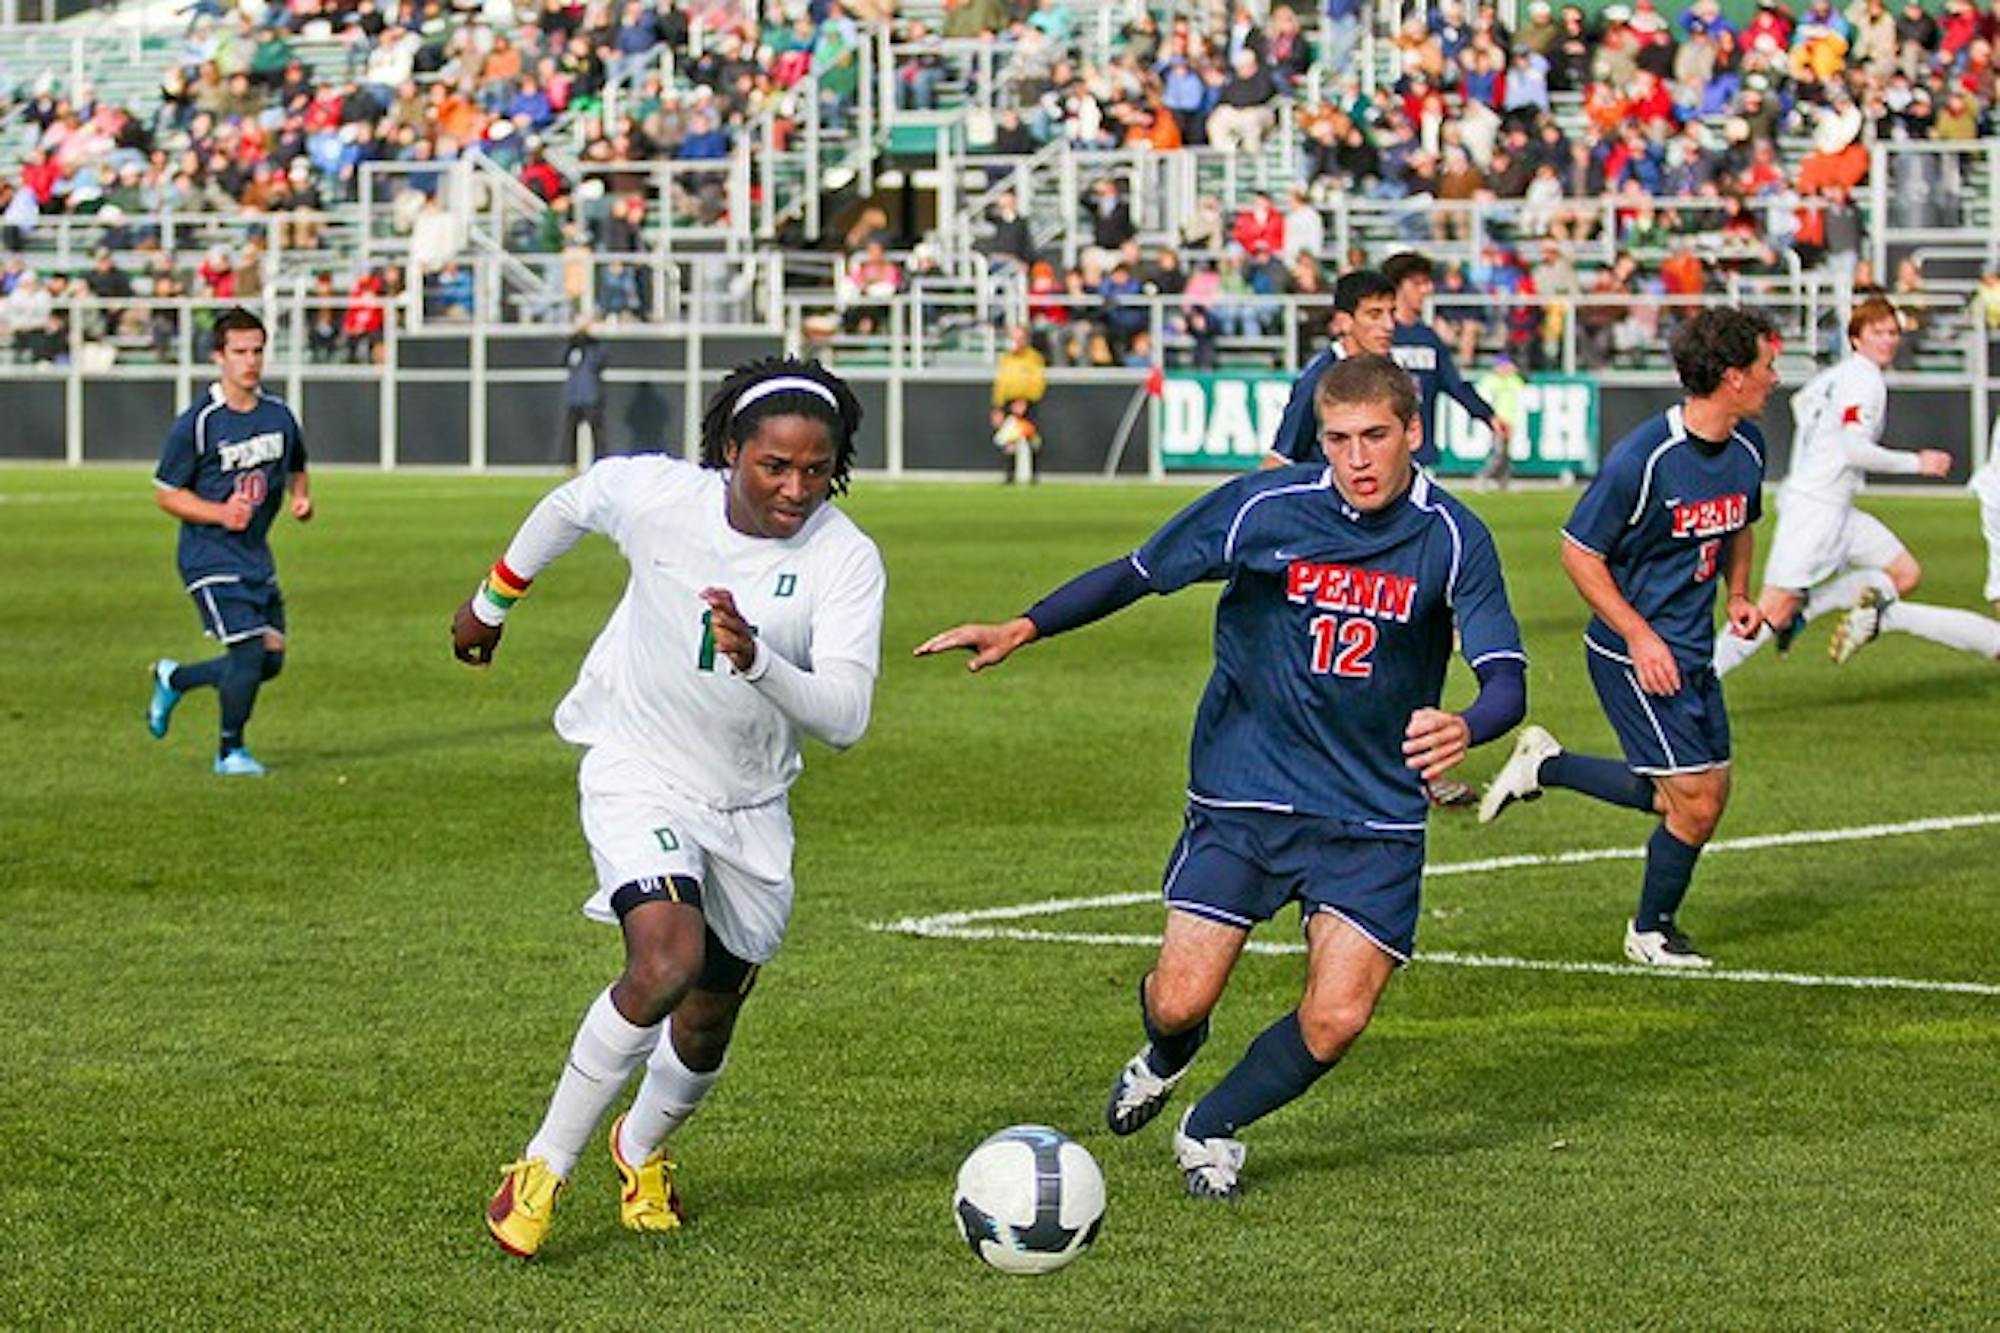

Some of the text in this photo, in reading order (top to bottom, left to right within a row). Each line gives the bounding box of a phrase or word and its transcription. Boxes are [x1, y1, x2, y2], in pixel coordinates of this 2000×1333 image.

[774, 573, 797, 597] D
[1287, 559, 1418, 623] PENN
[1310, 614, 1378, 678] 12
[653, 827, 679, 852] D
